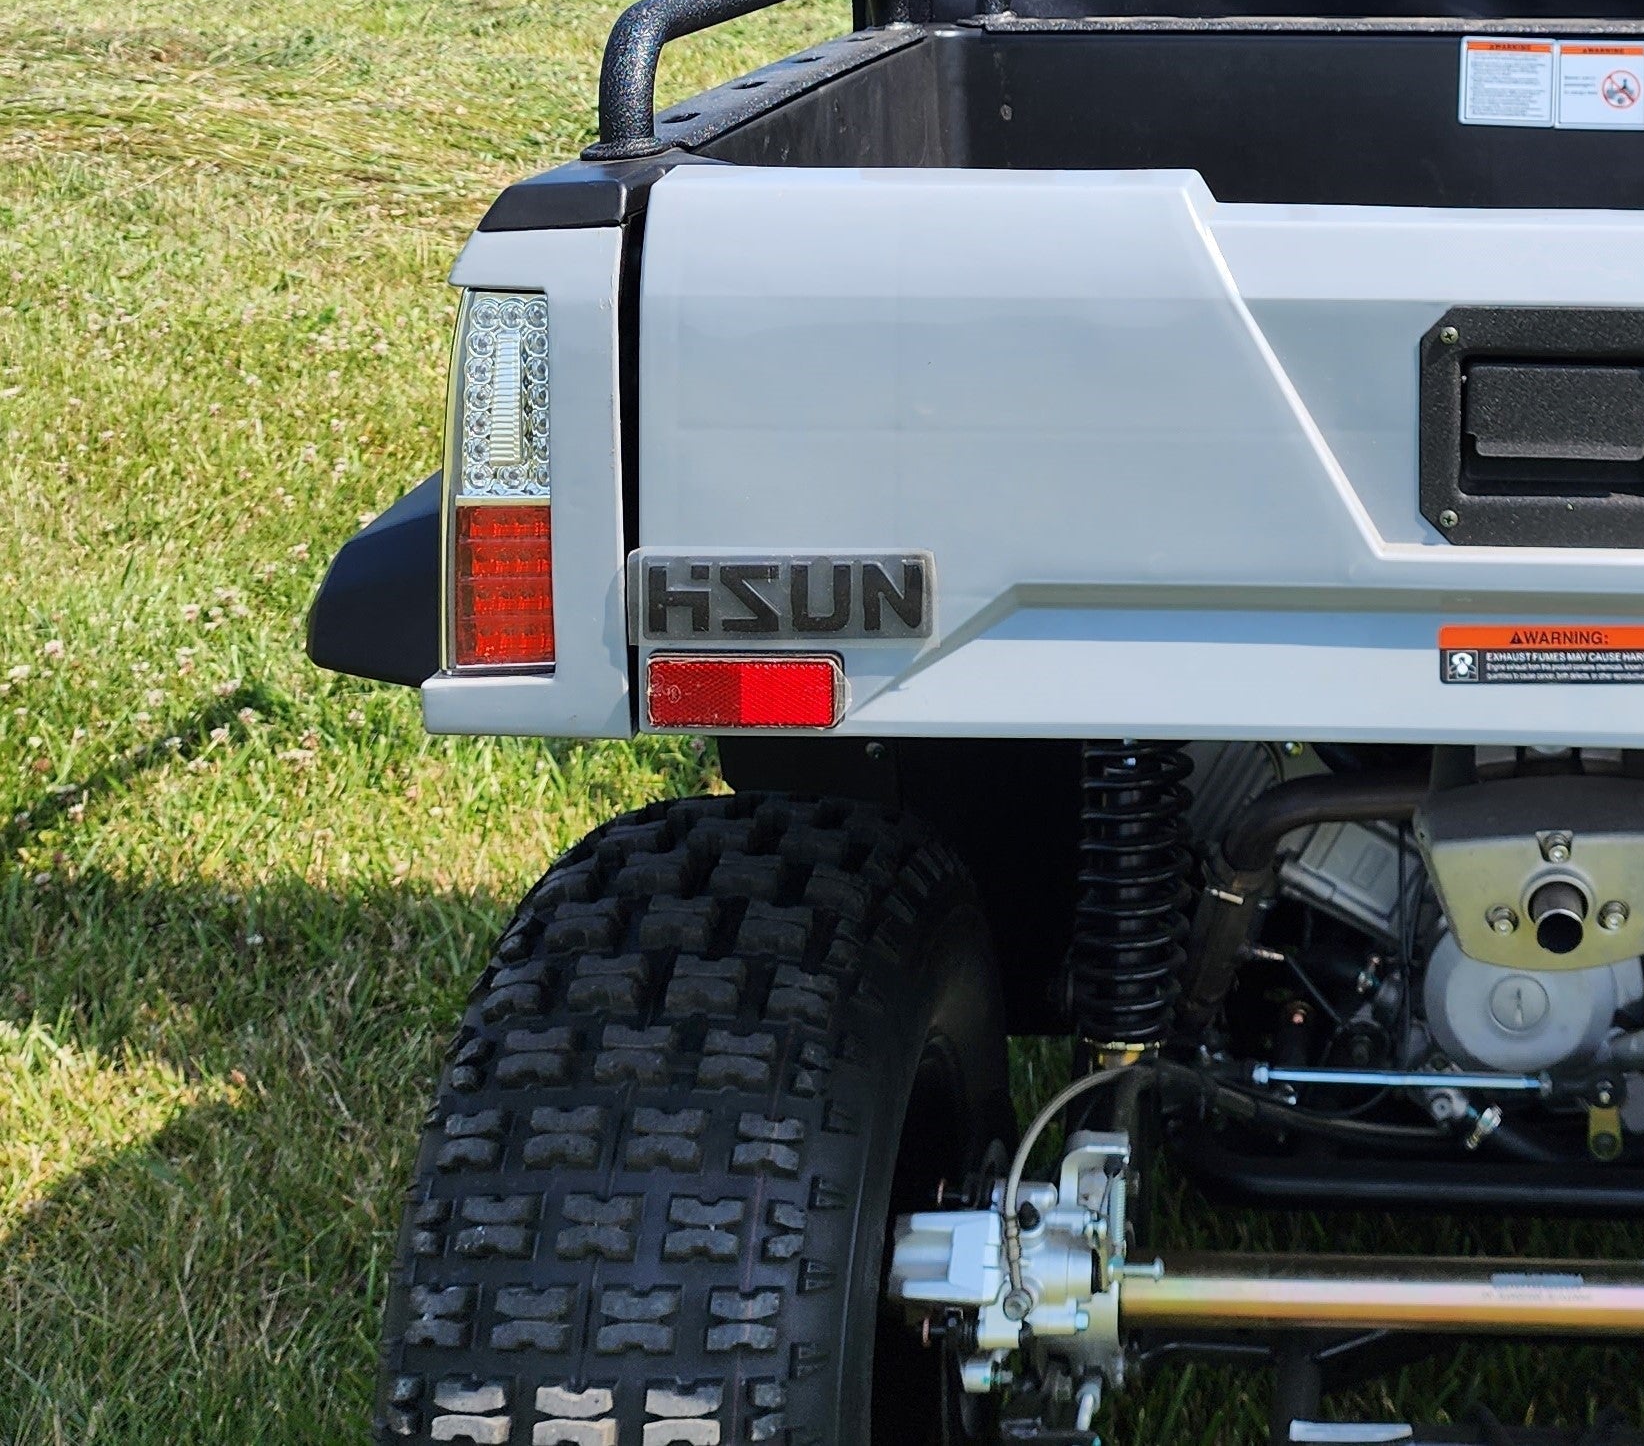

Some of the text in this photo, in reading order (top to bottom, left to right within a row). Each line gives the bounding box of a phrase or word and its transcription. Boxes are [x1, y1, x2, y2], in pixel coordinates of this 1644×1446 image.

[1525, 630, 1609, 645] WARNING:
[1485, 651, 1532, 662] EXHAUST
[1532, 651, 1567, 662] FUMES
[1567, 651, 1587, 662] MAY
[1588, 651, 1621, 662] CAUSE
